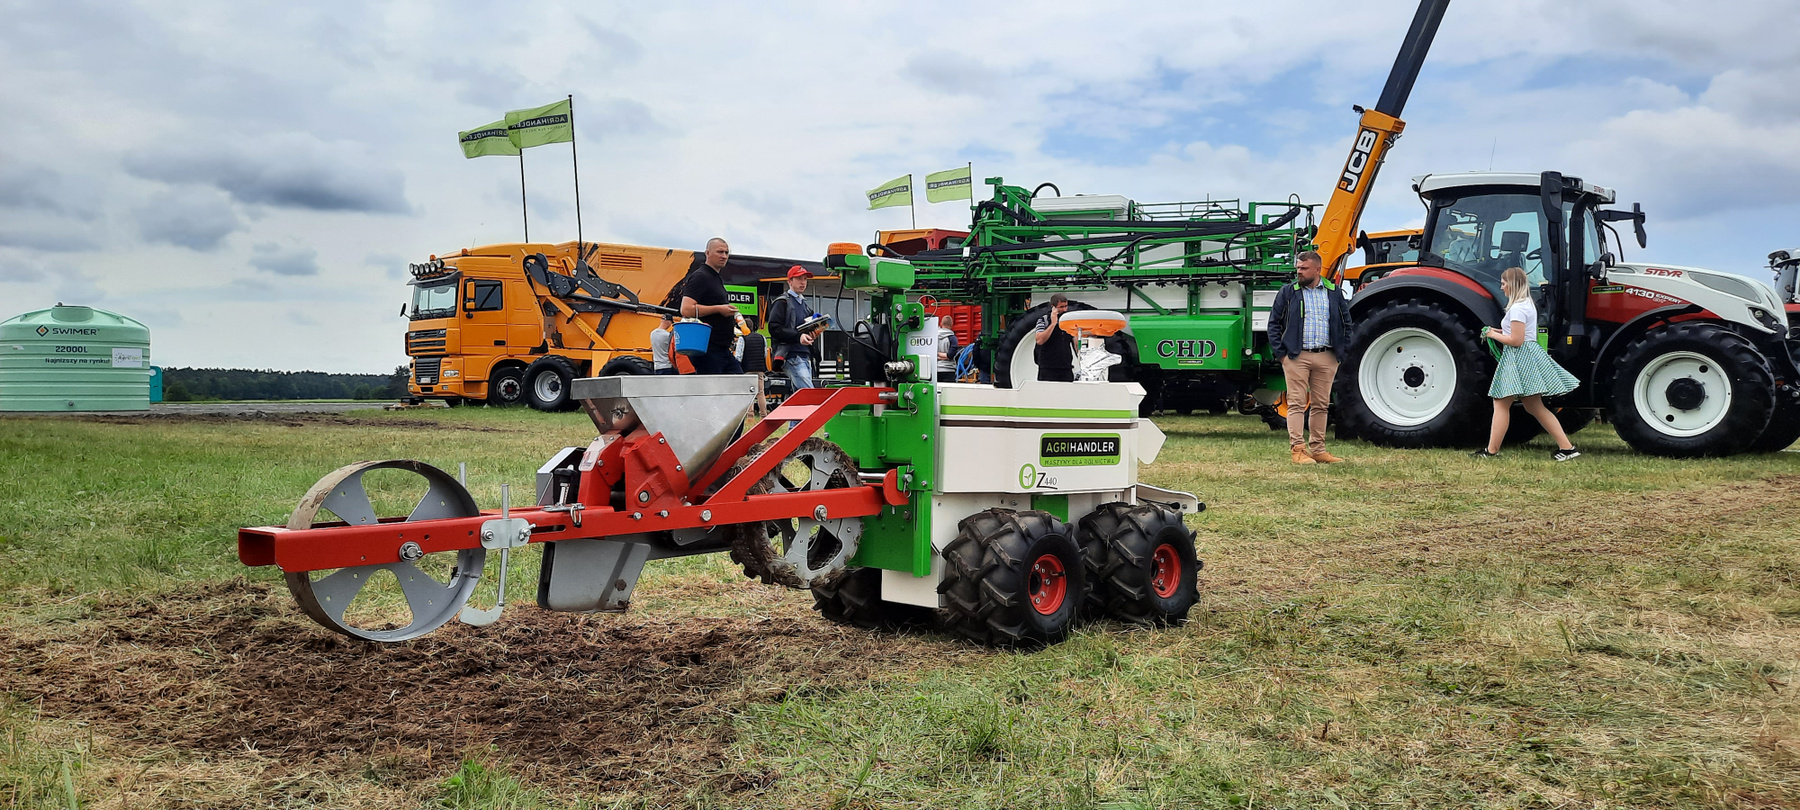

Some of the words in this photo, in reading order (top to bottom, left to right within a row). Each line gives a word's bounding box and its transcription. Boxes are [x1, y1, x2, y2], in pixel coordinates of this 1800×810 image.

[1344, 130, 1376, 191] JCB
[1644, 268, 1683, 278] STEYR
[1625, 287, 1655, 299] 4130
[1655, 293, 1682, 304] EXPERT
[52, 327, 98, 336] SWIMER
[55, 345, 88, 353] 22000L
[1157, 340, 1217, 358] CHD
[1046, 441, 1115, 453] AGRIHANDLER
